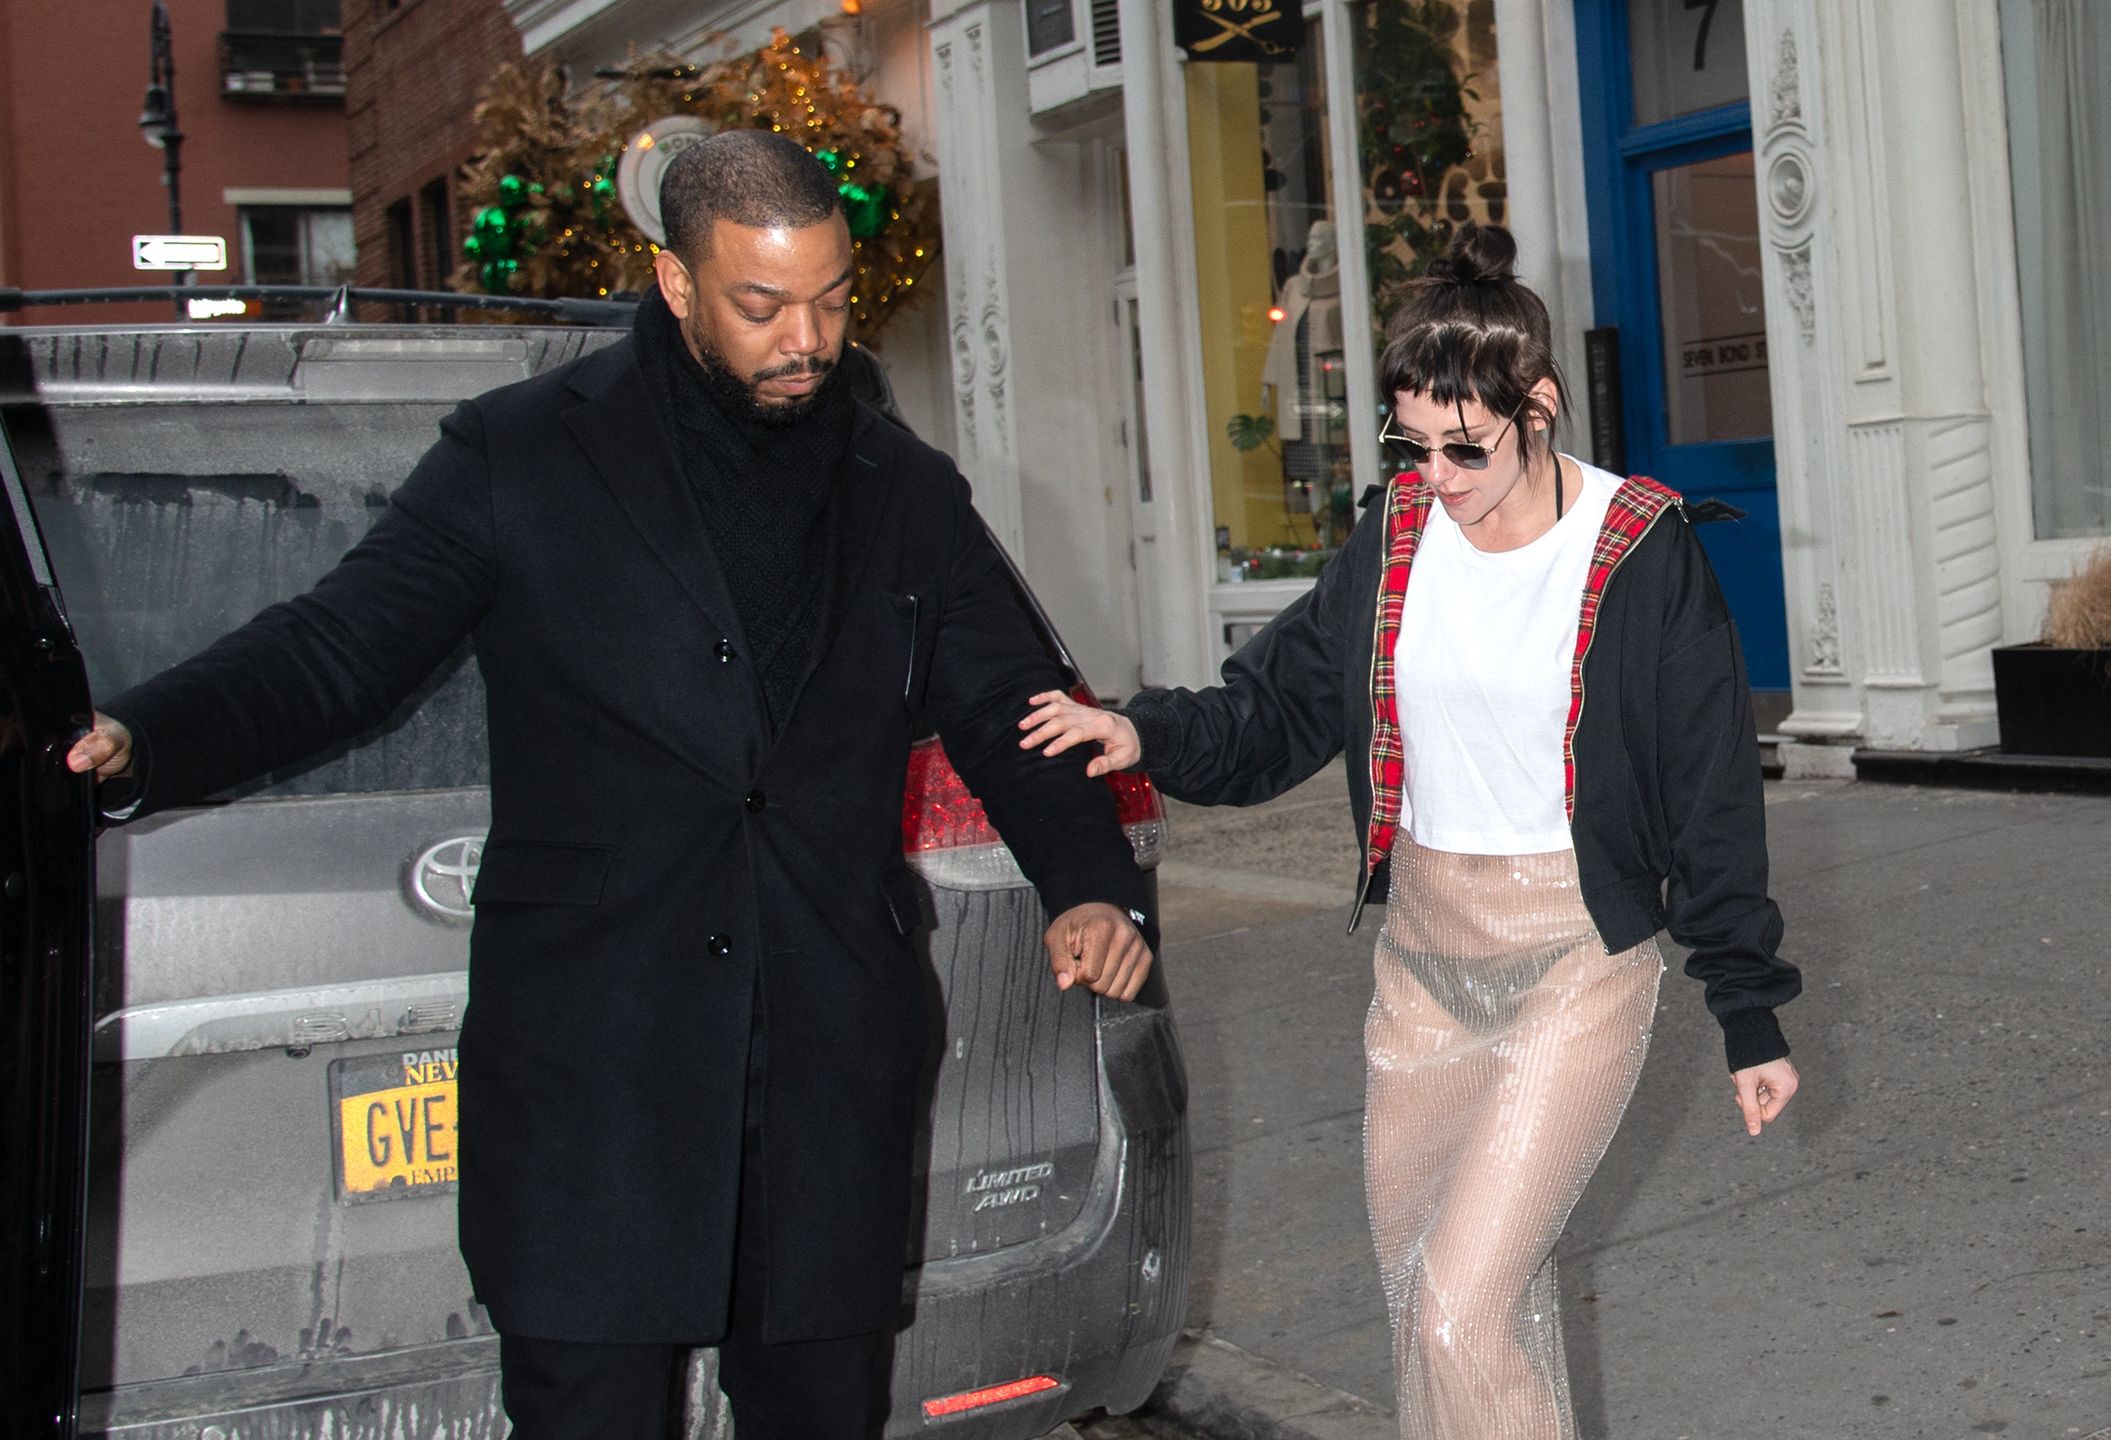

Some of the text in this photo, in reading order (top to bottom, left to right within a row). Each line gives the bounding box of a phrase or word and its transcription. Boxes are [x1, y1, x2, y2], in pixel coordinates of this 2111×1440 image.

[1683, 0, 1719, 70] 7
[967, 1162, 1054, 1193] LIMITED
[974, 1185, 1040, 1212] AWD
